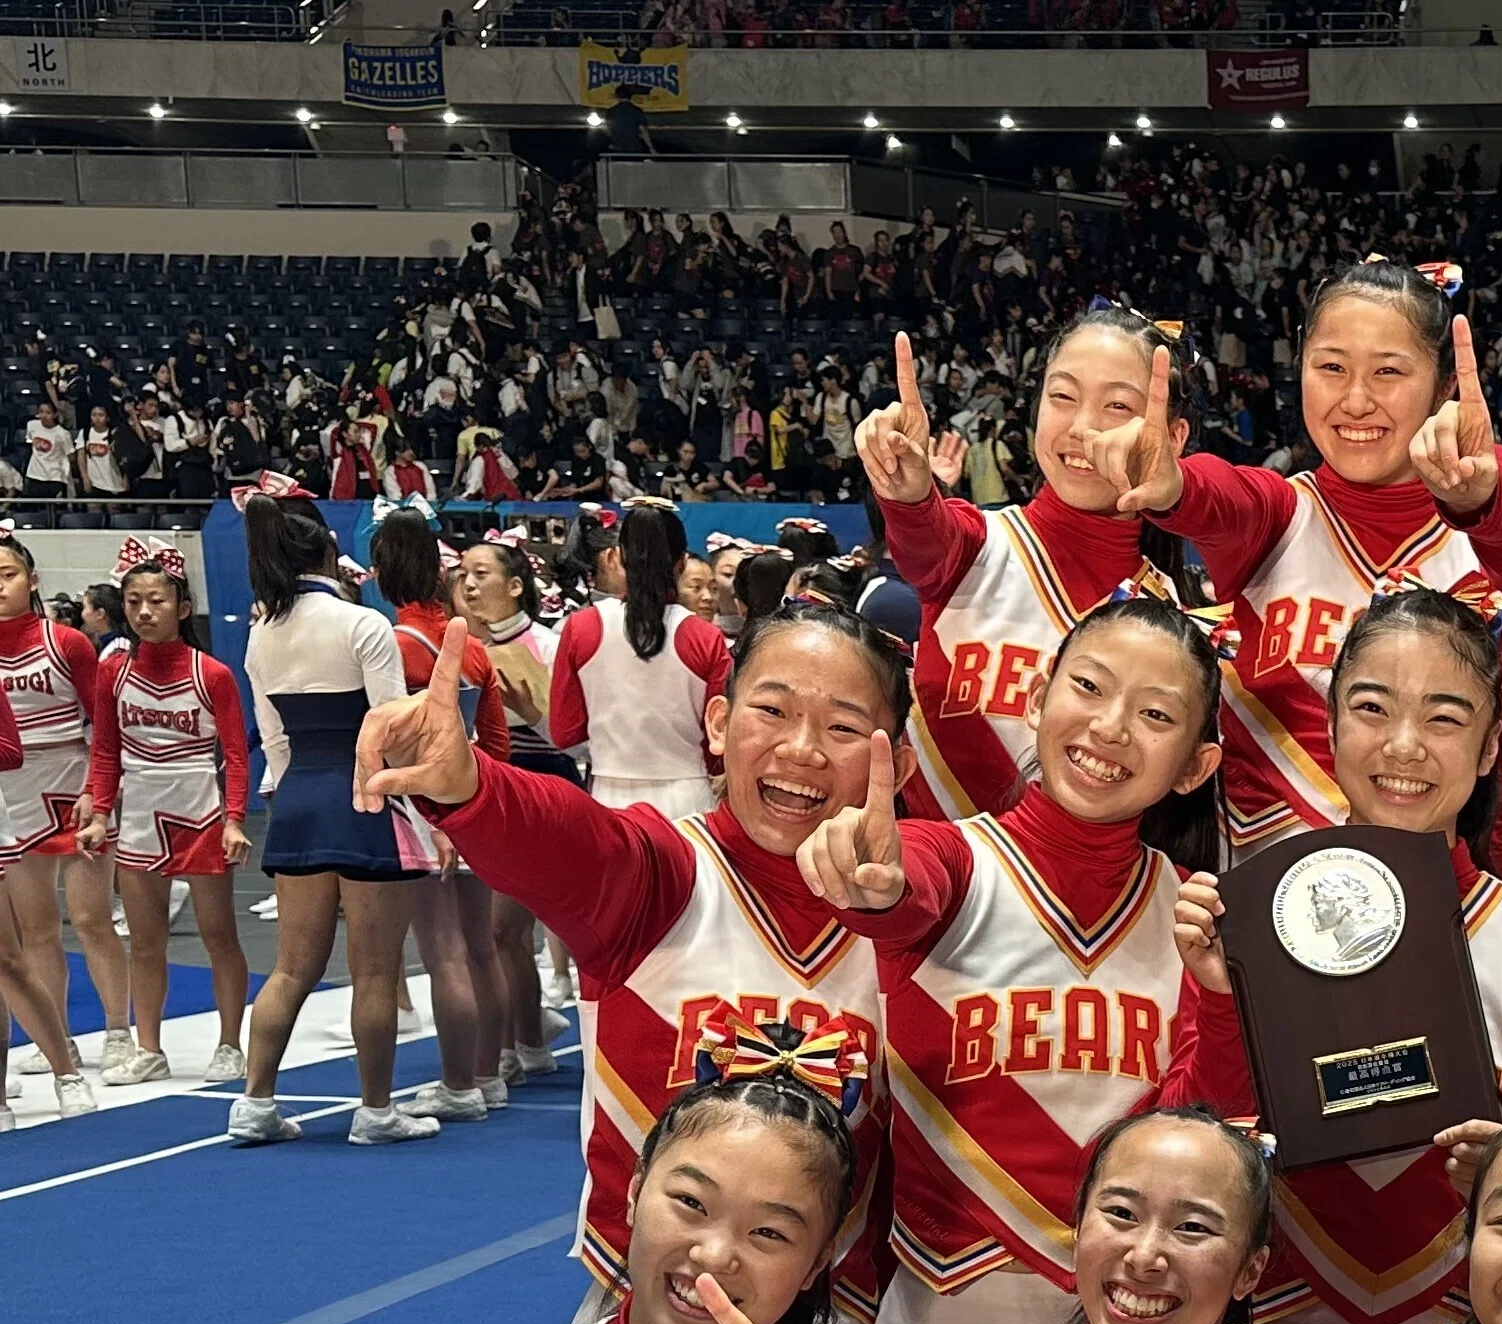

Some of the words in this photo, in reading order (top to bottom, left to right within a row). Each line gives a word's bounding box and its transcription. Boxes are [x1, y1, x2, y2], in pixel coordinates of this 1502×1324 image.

[27, 43, 57, 72] 北
[348, 57, 439, 85] GAZELLES
[23, 78, 65, 86] NORTH
[587, 60, 680, 96] HOPPERS
[1254, 595, 1366, 678] BE
[940, 640, 1050, 719] BE
[121, 700, 201, 737] ATSUGI
[944, 985, 1178, 1086] BEAR
